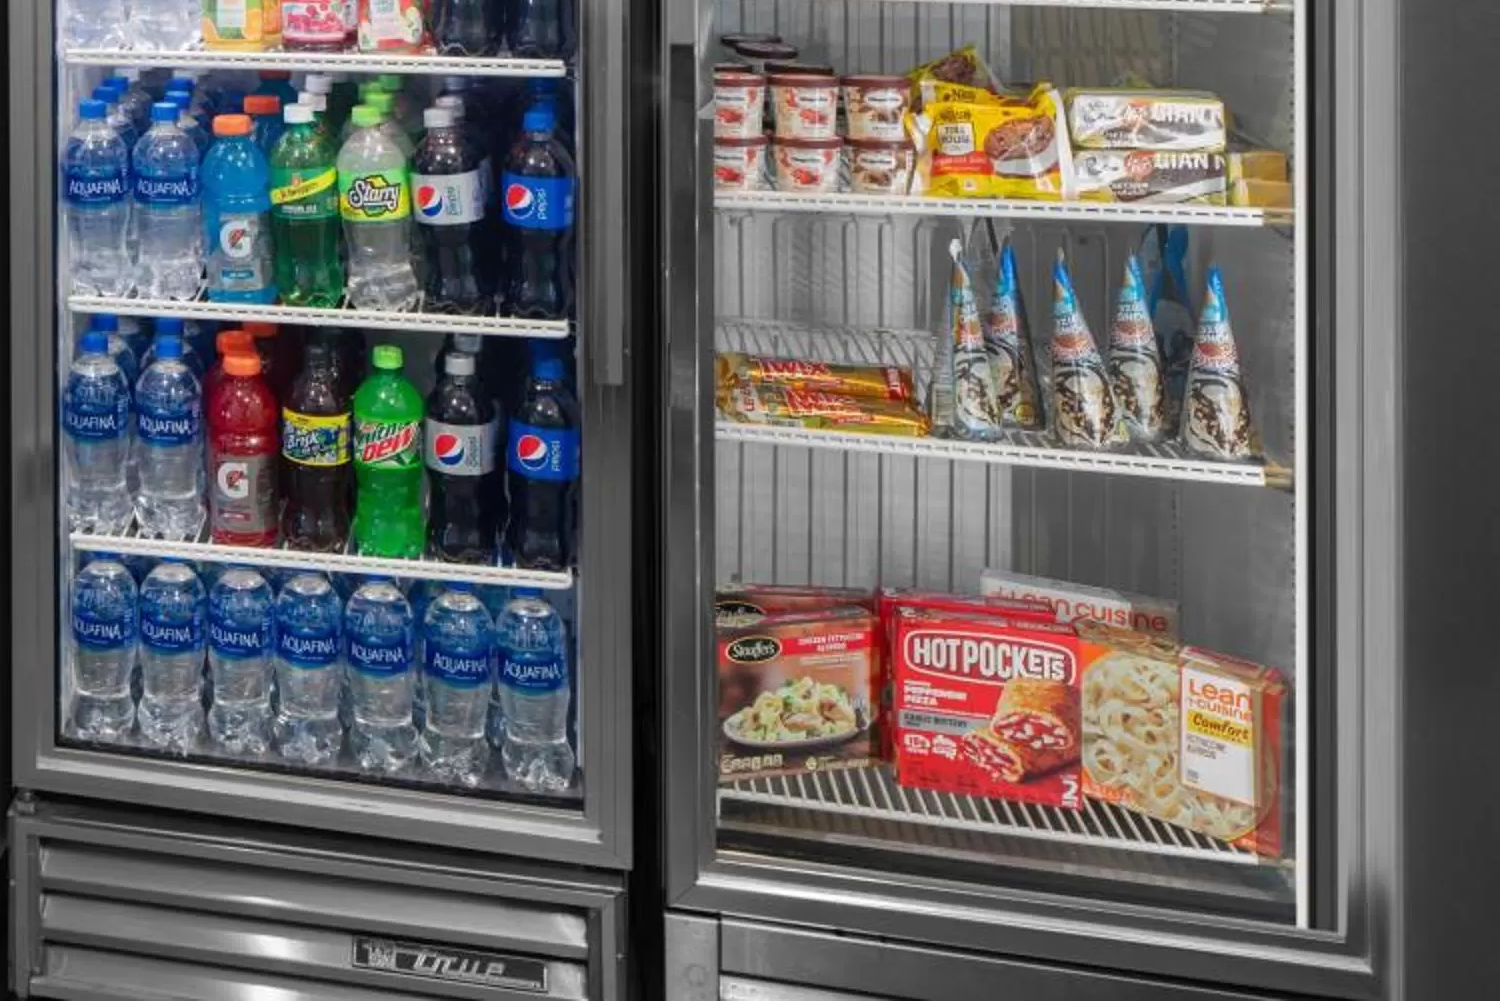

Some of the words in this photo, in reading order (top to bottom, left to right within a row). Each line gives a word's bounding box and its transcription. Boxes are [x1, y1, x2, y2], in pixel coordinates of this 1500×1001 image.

[70, 179, 122, 197] AQUAFINA
[138, 179, 192, 196] AQUAFINA
[350, 181, 399, 209] Starry
[140, 415, 191, 435] AQUAFINA
[1075, 602, 1169, 633] cuisine
[142, 622, 192, 641] AQUAFINA
[211, 624, 261, 647] AQUAFINA
[282, 635, 336, 655] AQUAFINA
[352, 642, 406, 664] AQUAFINA
[433, 652, 488, 673] AQUAFINA
[913, 637, 961, 673] HOT
[963, 640, 1066, 680] POCKETS
[504, 660, 562, 680] AQUAFINA
[1188, 678, 1253, 710] Lean
[1193, 712, 1249, 740] Comfort
[1062, 779, 1079, 799] 2
